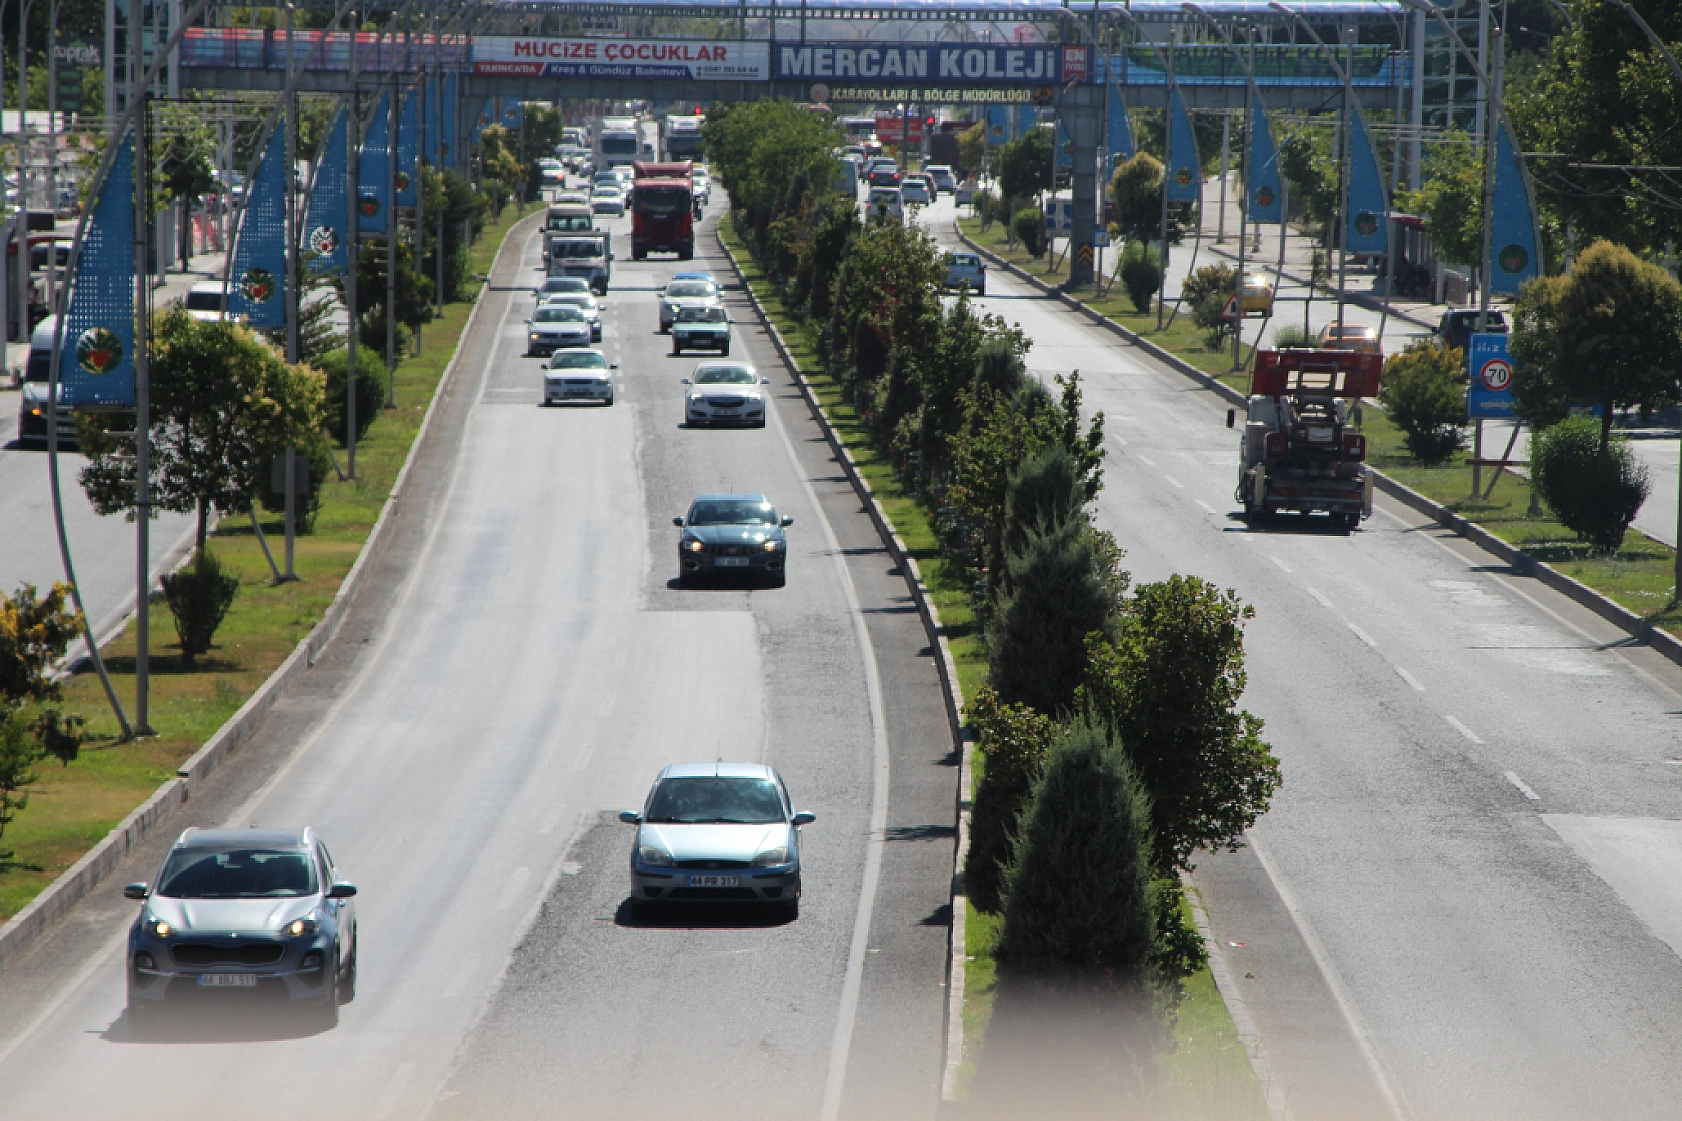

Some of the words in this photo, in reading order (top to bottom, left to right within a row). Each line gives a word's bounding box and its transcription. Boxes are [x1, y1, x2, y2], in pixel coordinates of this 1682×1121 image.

[604, 43, 727, 62] ÇOCUKLAR
[1065, 48, 1085, 61] EN
[780, 46, 928, 77] MERCAN
[578, 65, 586, 75] &
[589, 65, 632, 76] Gündüz
[833, 87, 908, 101] KARAYOLLARI
[924, 88, 961, 101] BÖLGE
[962, 88, 1031, 102] MÜDÜRLÜĞÜ
[1488, 368, 1507, 382] 70
